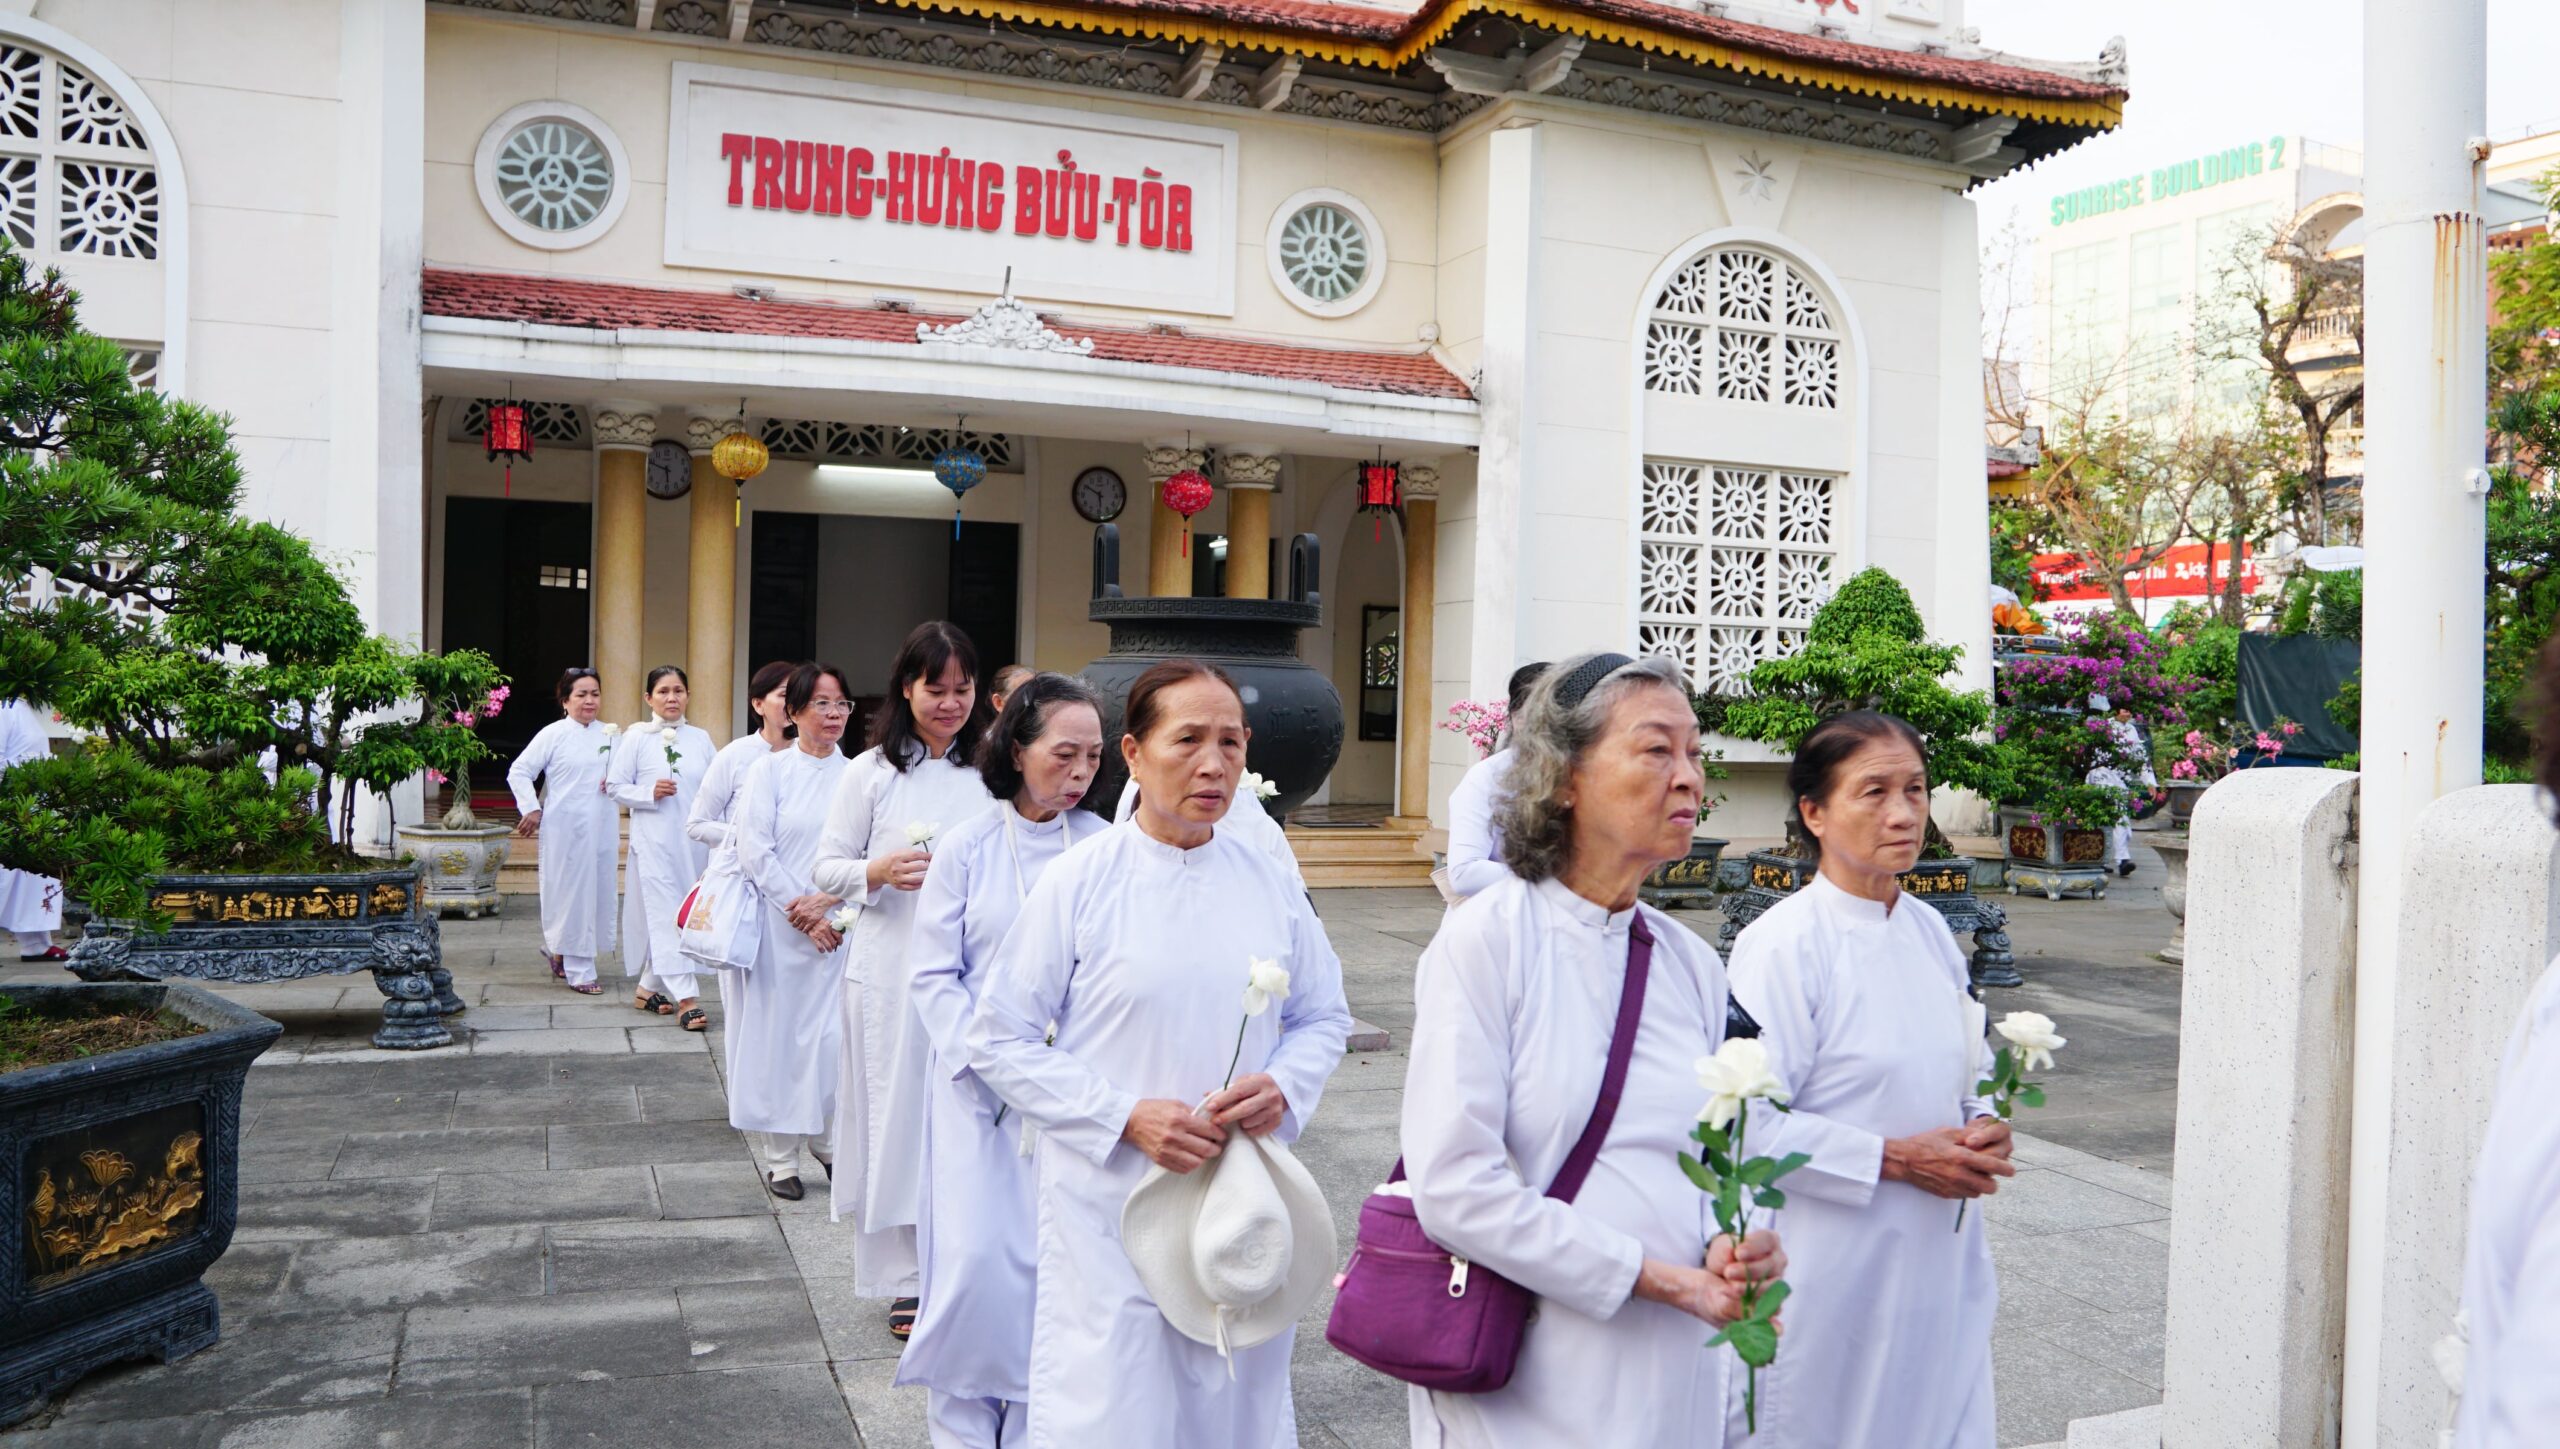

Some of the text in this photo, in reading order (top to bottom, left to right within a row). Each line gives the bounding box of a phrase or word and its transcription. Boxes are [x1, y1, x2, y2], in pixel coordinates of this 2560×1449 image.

[722, 132, 1005, 232] TRUNG-HƯNG
[2051, 135, 2286, 227] SUNRISE BUILDING 2
[2216, 559, 2265, 579] IETS
